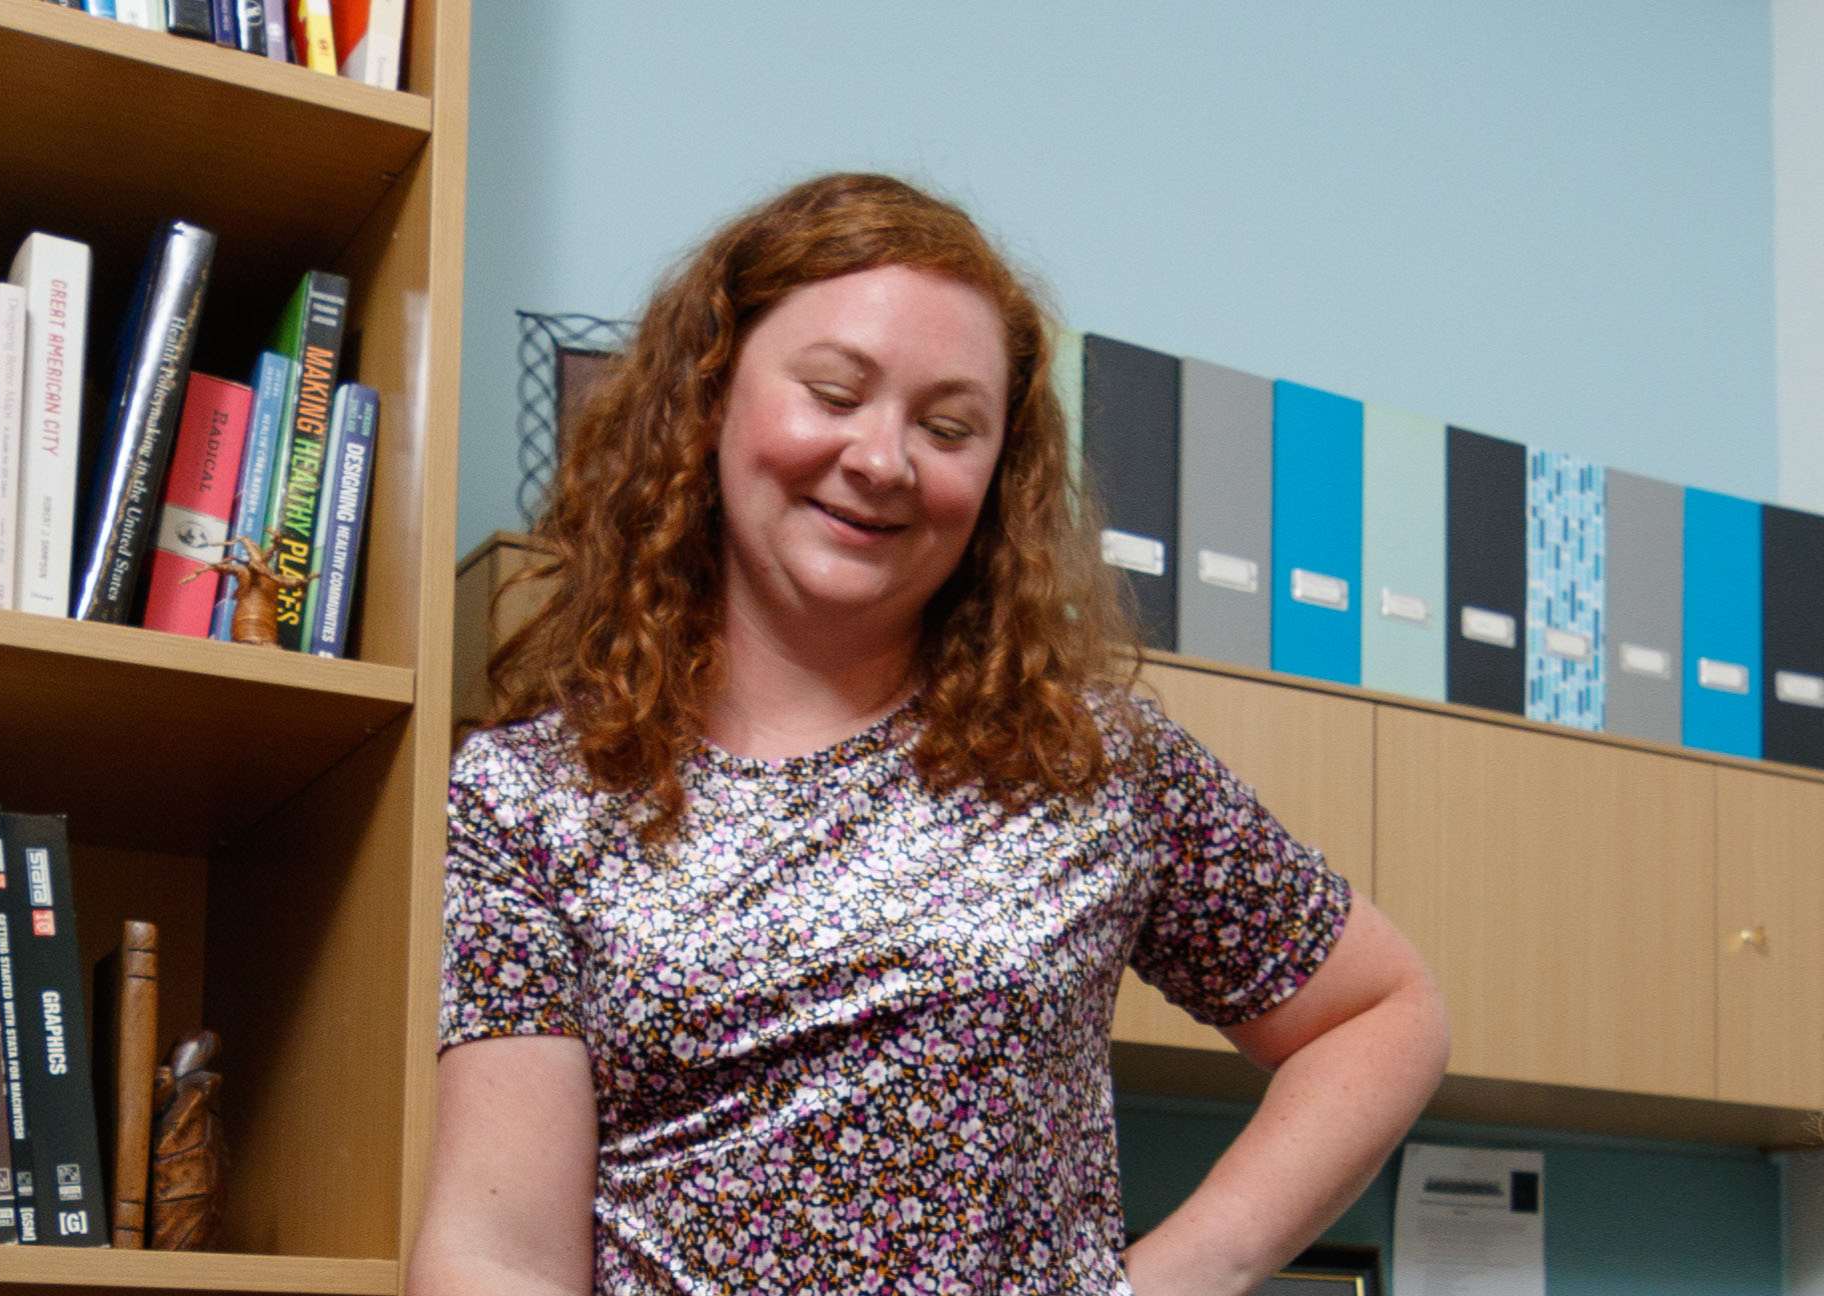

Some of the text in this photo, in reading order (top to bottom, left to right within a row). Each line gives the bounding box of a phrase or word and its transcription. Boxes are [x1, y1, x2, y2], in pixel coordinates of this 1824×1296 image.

[40, 278, 68, 458] GREAT AMERICAN CITY
[107, 315, 186, 600] Health Policymaking the United States
[198, 408, 230, 494] RADICAL
[283, 346, 335, 537] MAKING HEALTHY
[335, 442, 366, 523] DESIGNING
[330, 524, 351, 568] HEALTHY
[321, 565, 348, 644] COMMUNITIES
[2, 1001, 16, 1026] WITH
[4, 1025, 20, 1061] STATA
[41, 989, 68, 1077] GRAPHICS
[8, 1060, 22, 1080] FOR
[9, 1079, 28, 1140] MACINTOSH
[19, 1207, 37, 1242] [GSM]
[58, 1210, 89, 1236] [G]
